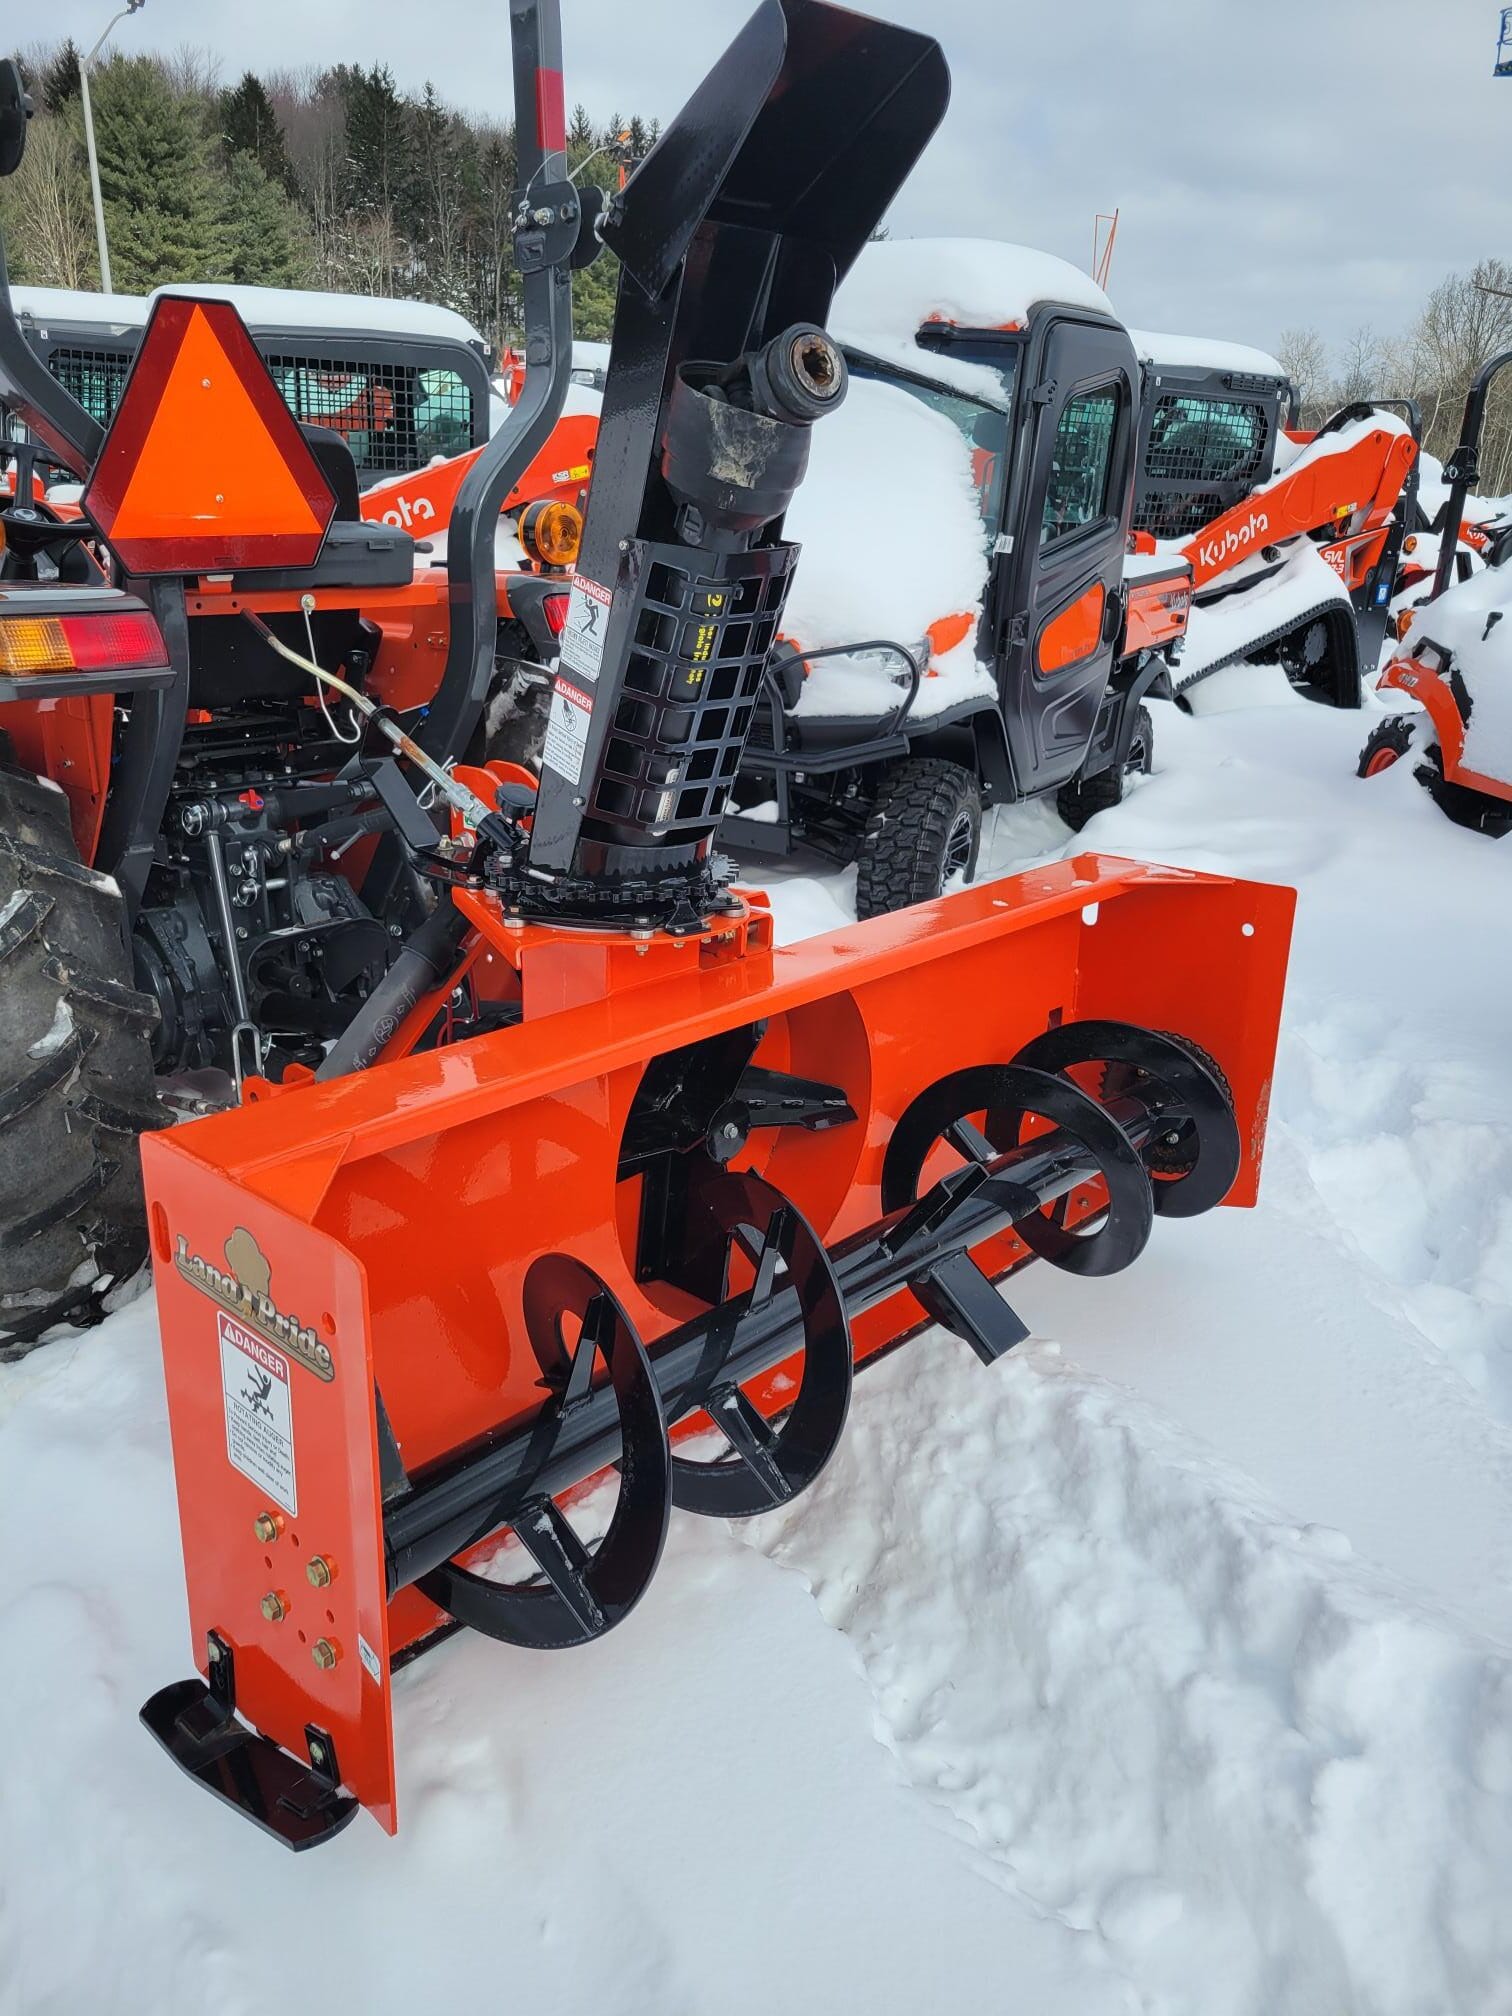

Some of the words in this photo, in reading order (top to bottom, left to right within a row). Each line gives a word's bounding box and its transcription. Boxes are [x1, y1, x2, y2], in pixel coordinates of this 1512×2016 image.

[1200, 512, 1269, 567] Kubota
[1324, 550, 1345, 564] SVL
[580, 580, 611, 605] DANGER
[561, 683, 593, 711] DANGER
[175, 1233, 240, 1305] Land
[257, 1290, 331, 1369] Pride
[234, 1329, 284, 1378] DANGER
[233, 1402, 262, 1430] ROTATING
[264, 1425, 285, 1448] AUGER
